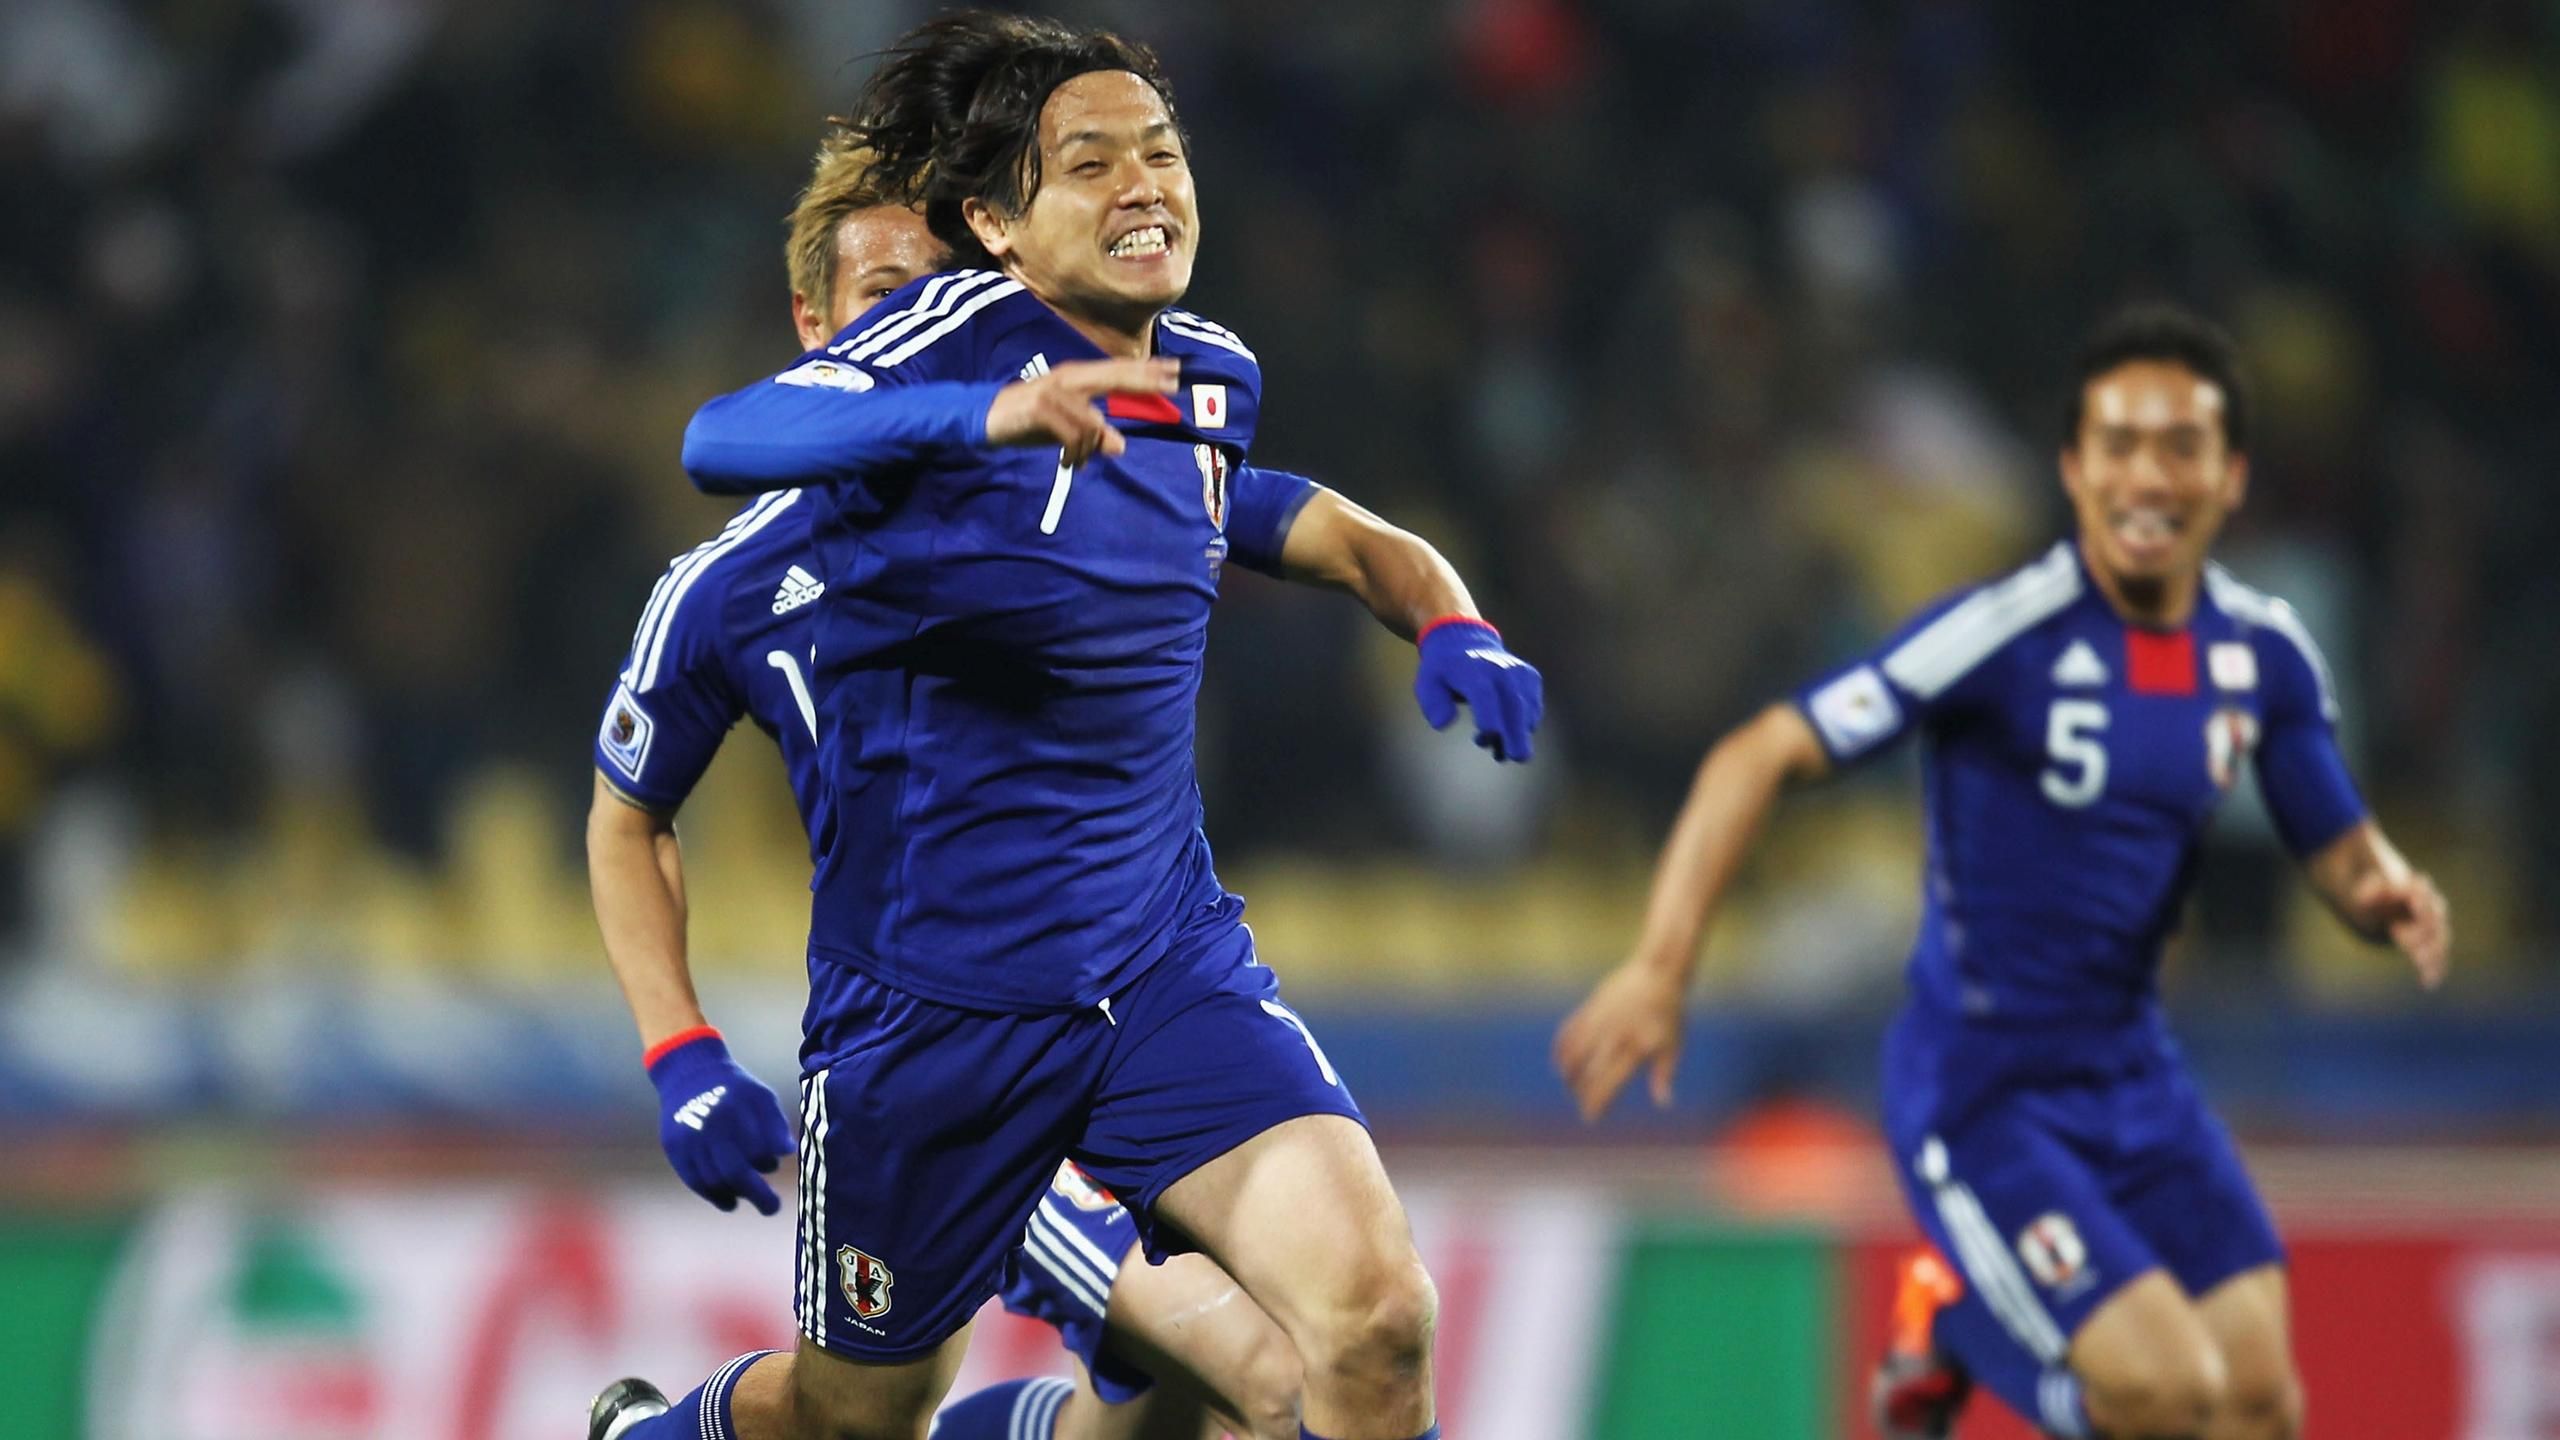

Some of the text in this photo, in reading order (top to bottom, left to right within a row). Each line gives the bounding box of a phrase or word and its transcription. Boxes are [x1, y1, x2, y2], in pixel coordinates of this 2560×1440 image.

[771, 581, 827, 616] adida
[2039, 698, 2112, 808] 5
[843, 1315, 887, 1337] JAPAN
